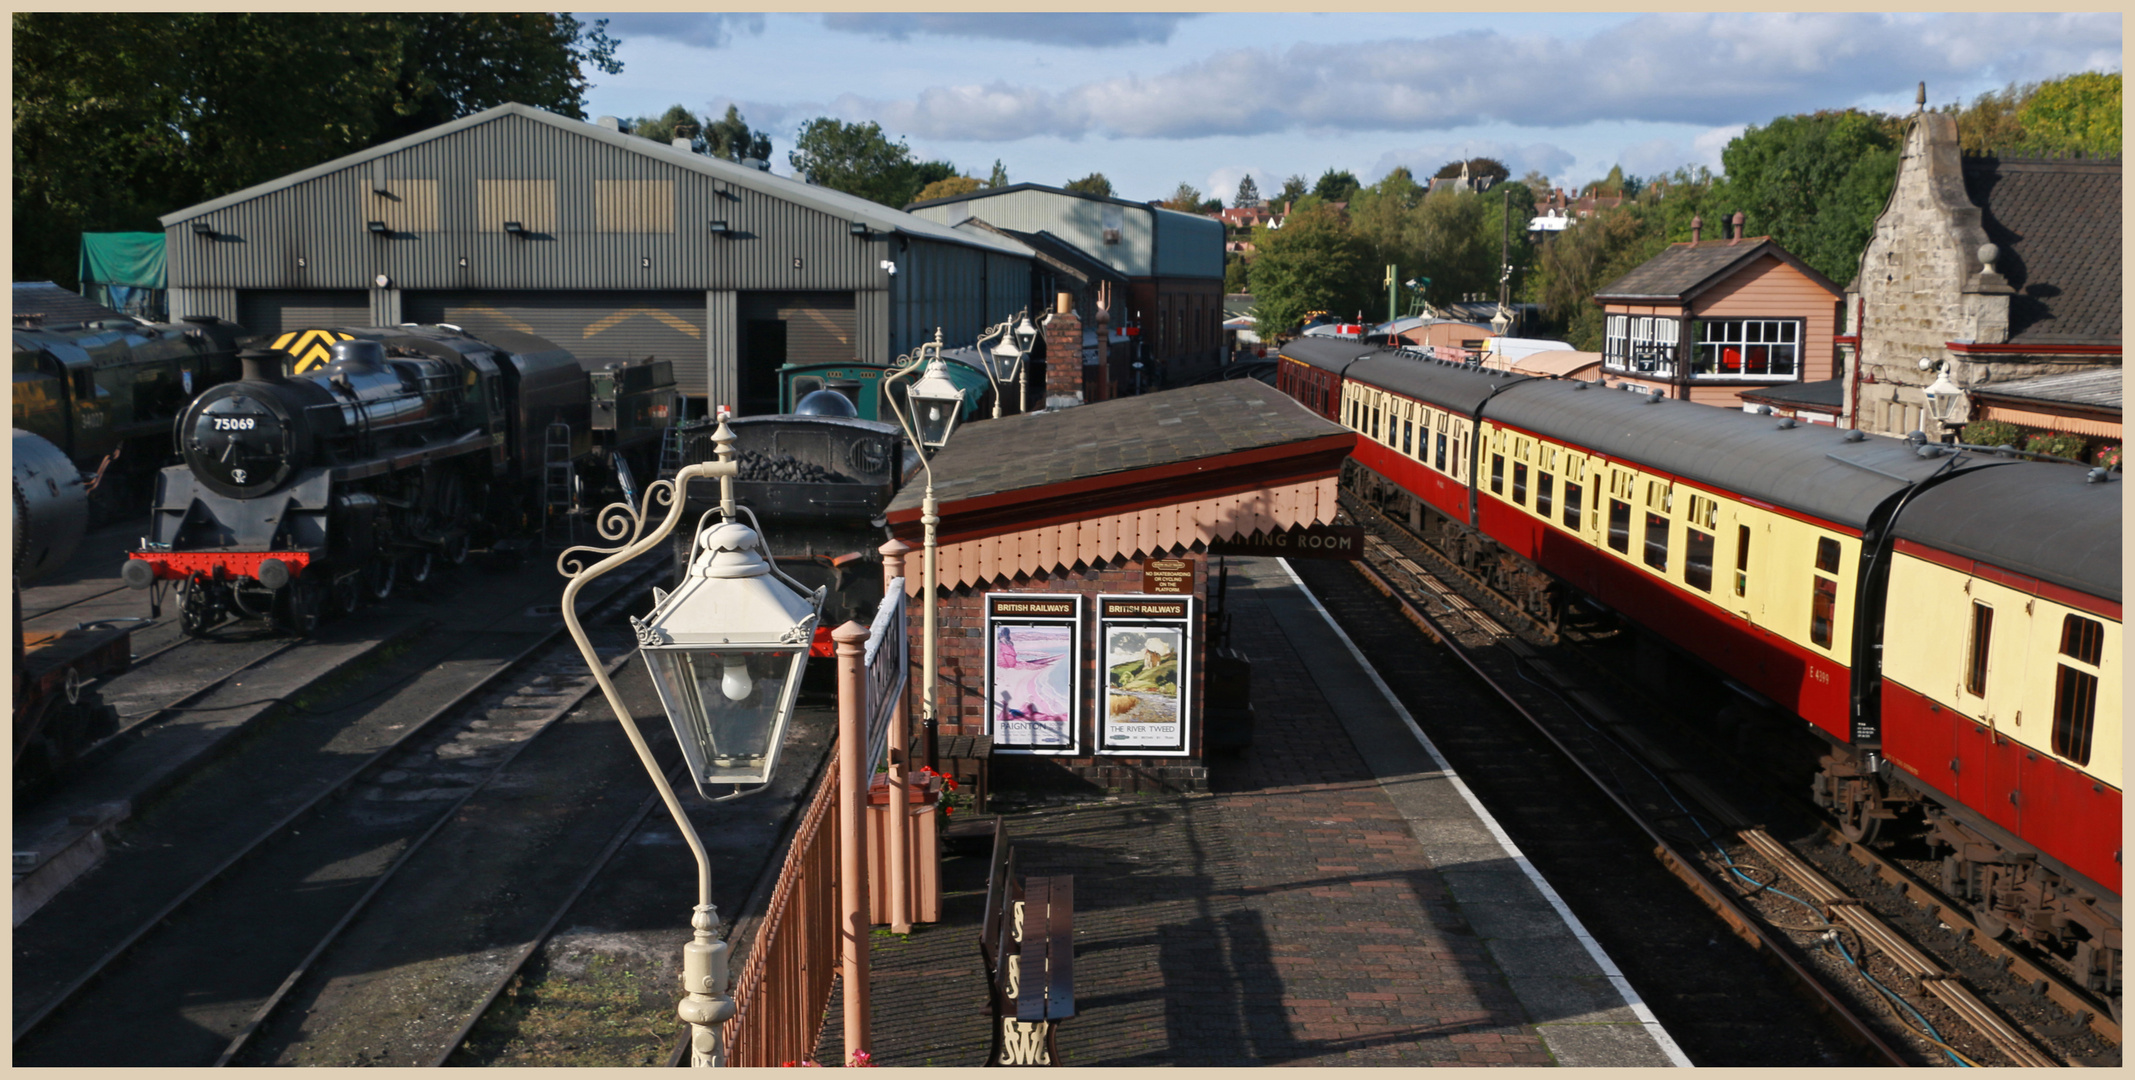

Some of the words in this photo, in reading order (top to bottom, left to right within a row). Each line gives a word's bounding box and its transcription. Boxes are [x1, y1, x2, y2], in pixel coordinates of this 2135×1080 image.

[298, 257, 306, 267] 5
[459, 257, 467, 267] 4
[642, 257, 650, 267] 3
[794, 258, 801, 268] 2
[214, 418, 255, 430] 75069
[1297, 535, 1352, 550] ROOM
[997, 603, 1029, 612] BRITISH
[1029, 604, 1070, 613] RAILWAYS
[1108, 605, 1140, 613] BRITISH
[1141, 605, 1181, 614] RAILWAYS
[1809, 666, 1814, 678] E
[1000, 722, 1047, 731] PAIGNTON
[1110, 725, 1124, 733] THE
[1126, 725, 1146, 733] RIVER
[1149, 725, 1175, 733] TWEED
